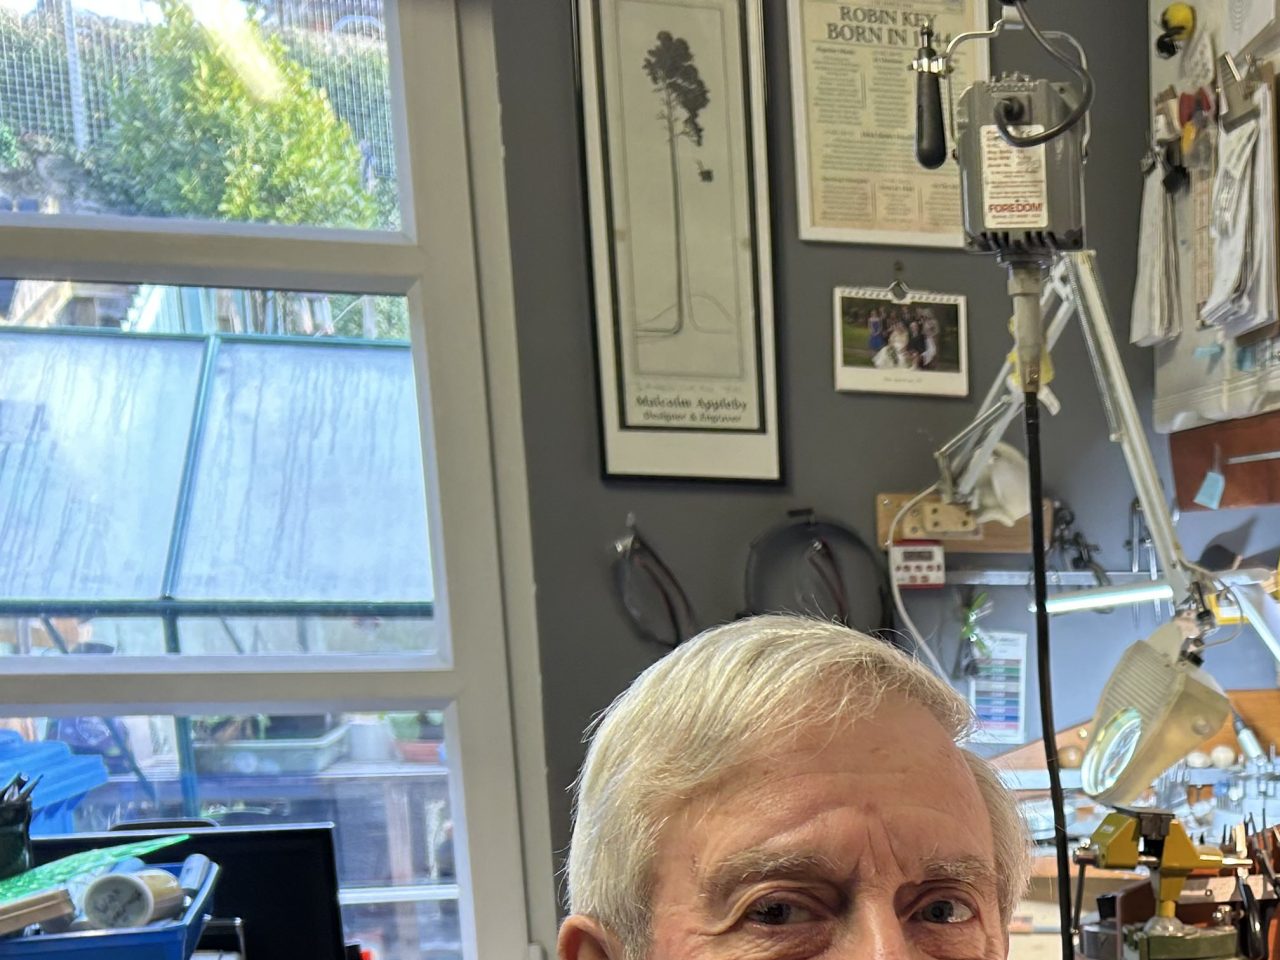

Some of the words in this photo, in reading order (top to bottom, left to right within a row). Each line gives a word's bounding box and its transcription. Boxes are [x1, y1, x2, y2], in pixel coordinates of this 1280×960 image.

[839, 6, 898, 25] ROBIN
[902, 12, 938, 27] KEY
[827, 23, 883, 44] BORN
[888, 29, 908, 45] IN
[913, 30, 951, 48] 144
[988, 202, 1043, 213] FOREDOM
